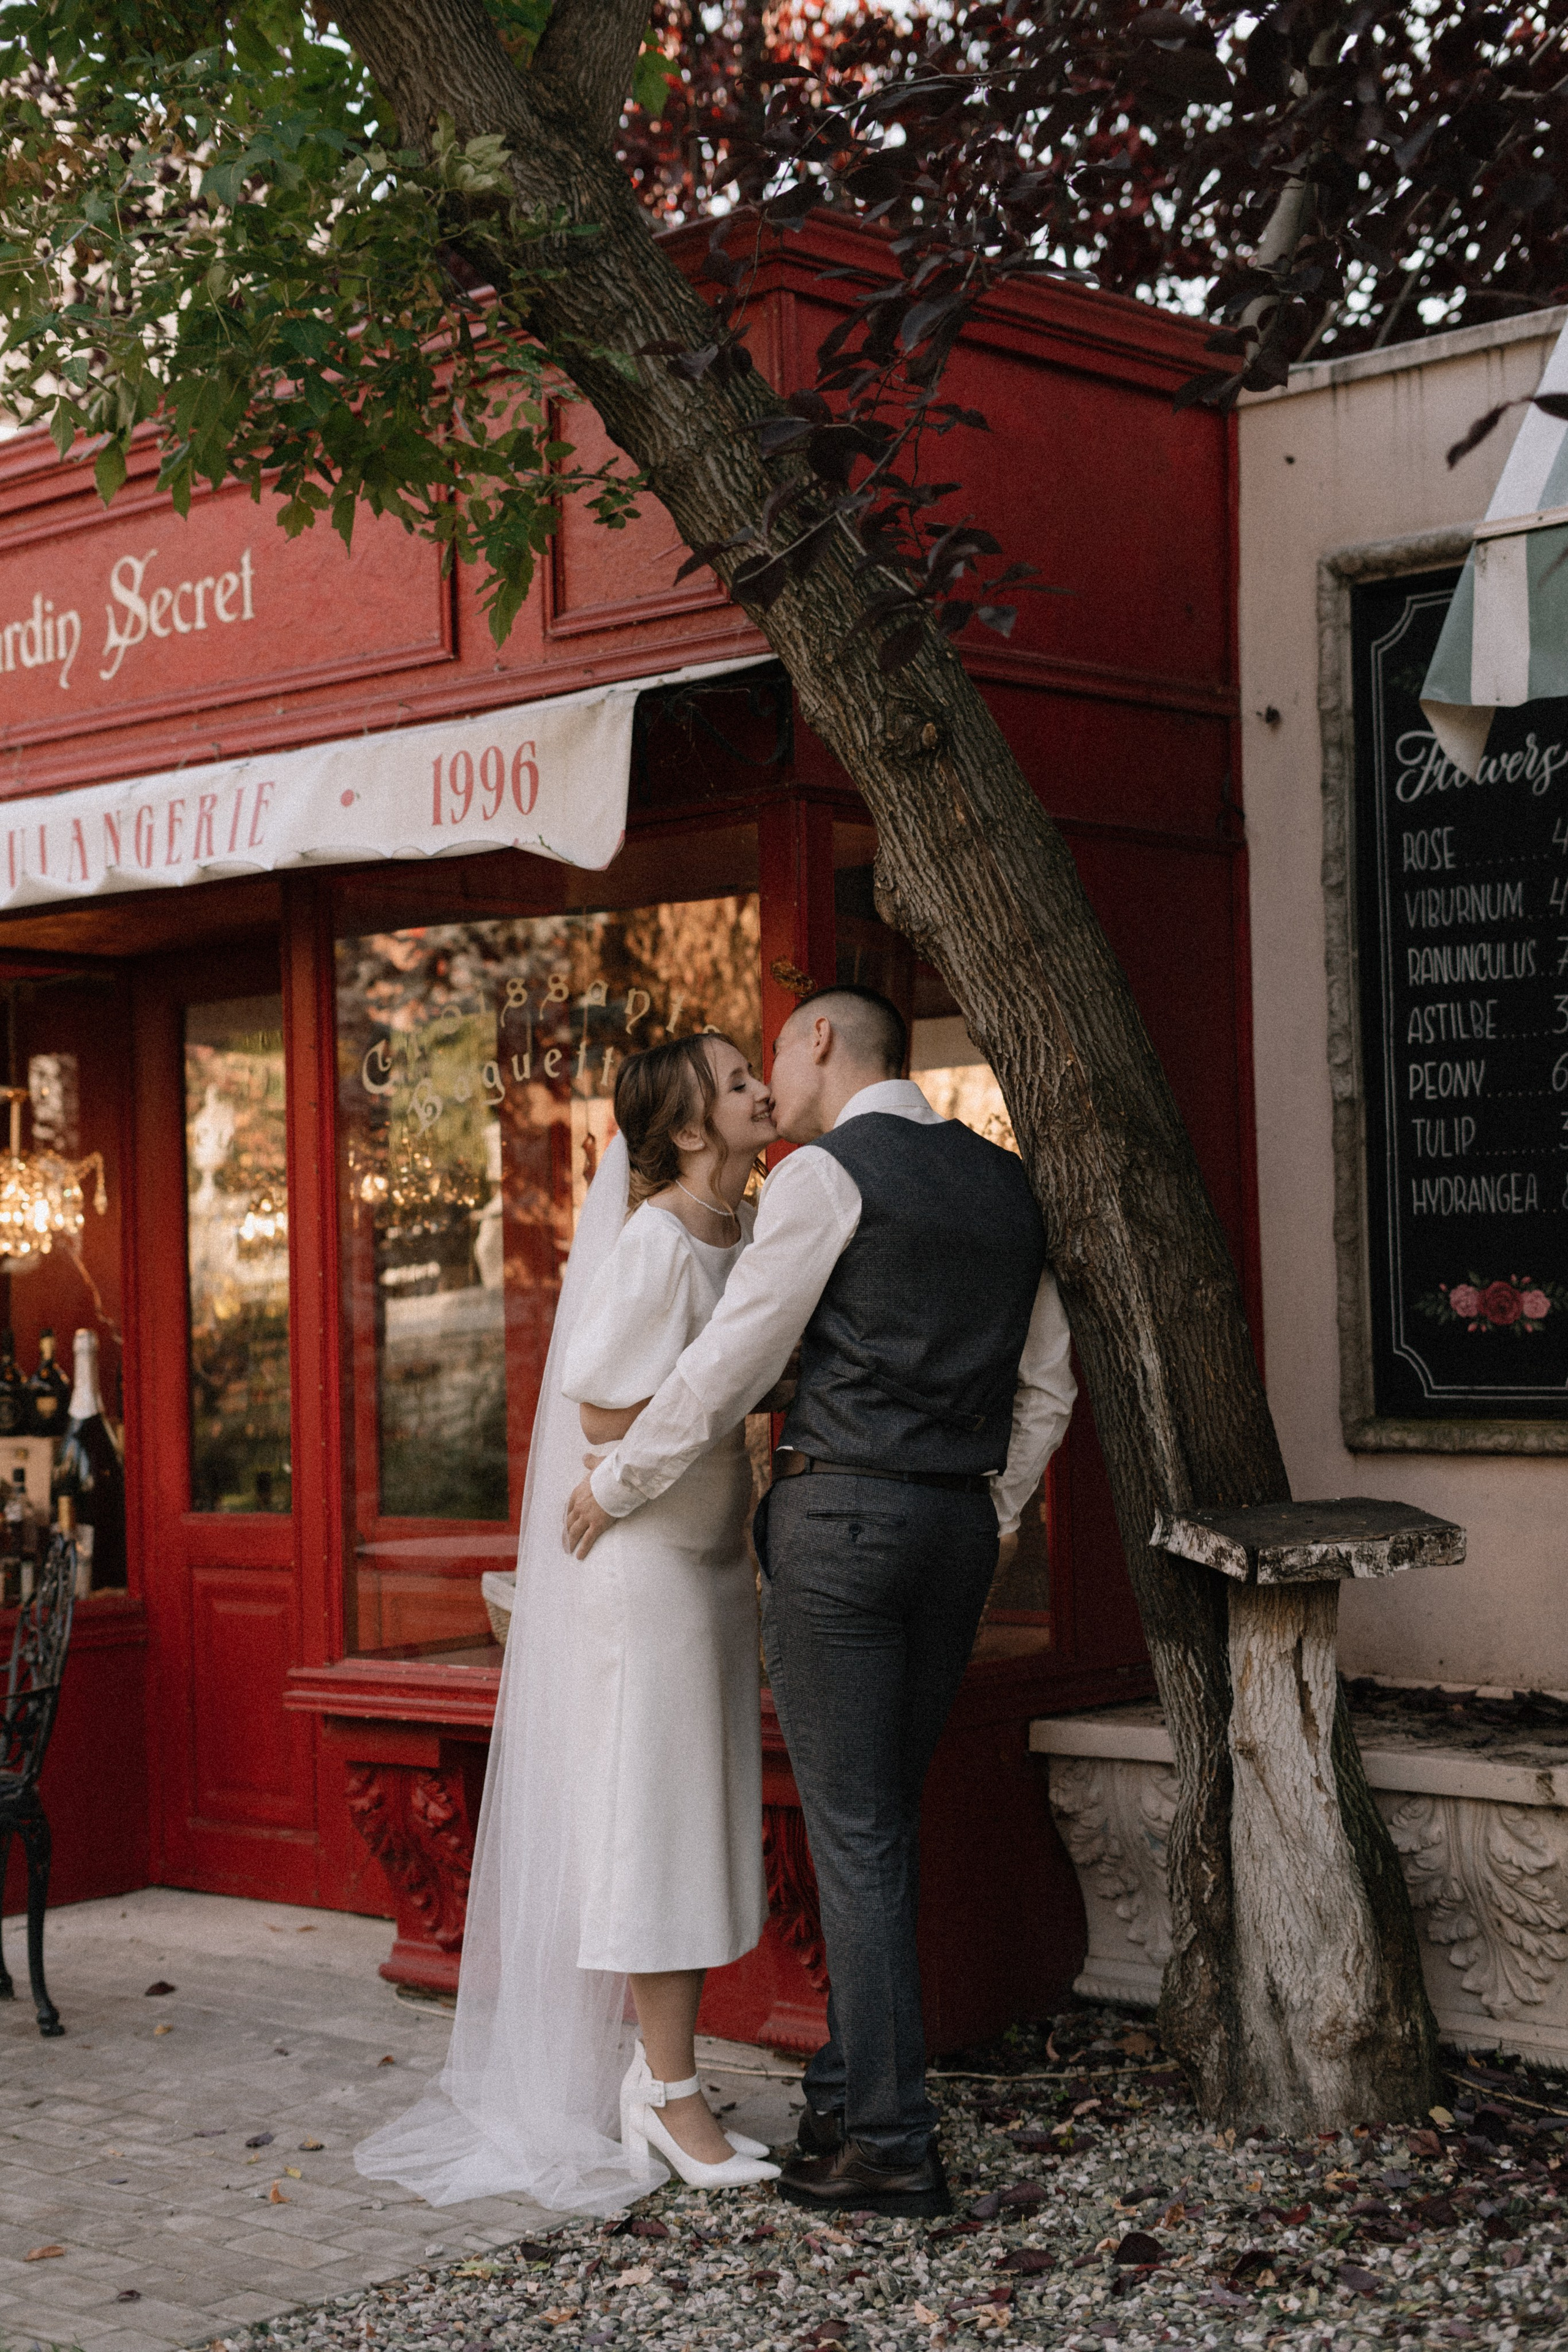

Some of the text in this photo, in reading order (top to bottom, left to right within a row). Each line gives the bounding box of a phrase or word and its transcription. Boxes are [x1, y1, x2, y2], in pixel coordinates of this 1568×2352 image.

[0, 548, 255, 690] rdin Secret
[432, 741, 539, 826] 1996
[1403, 827, 1457, 872] ROSE
[1404, 881, 1524, 929] VIBURNUM
[1408, 939, 1536, 986] RANUNCULUS
[1408, 1000, 1498, 1044] ASTILBE
[1409, 1060, 1485, 1100] PEONY
[1411, 1117, 1476, 1157] TULIP
[1412, 1172, 1539, 1216] HYDRANGEA
